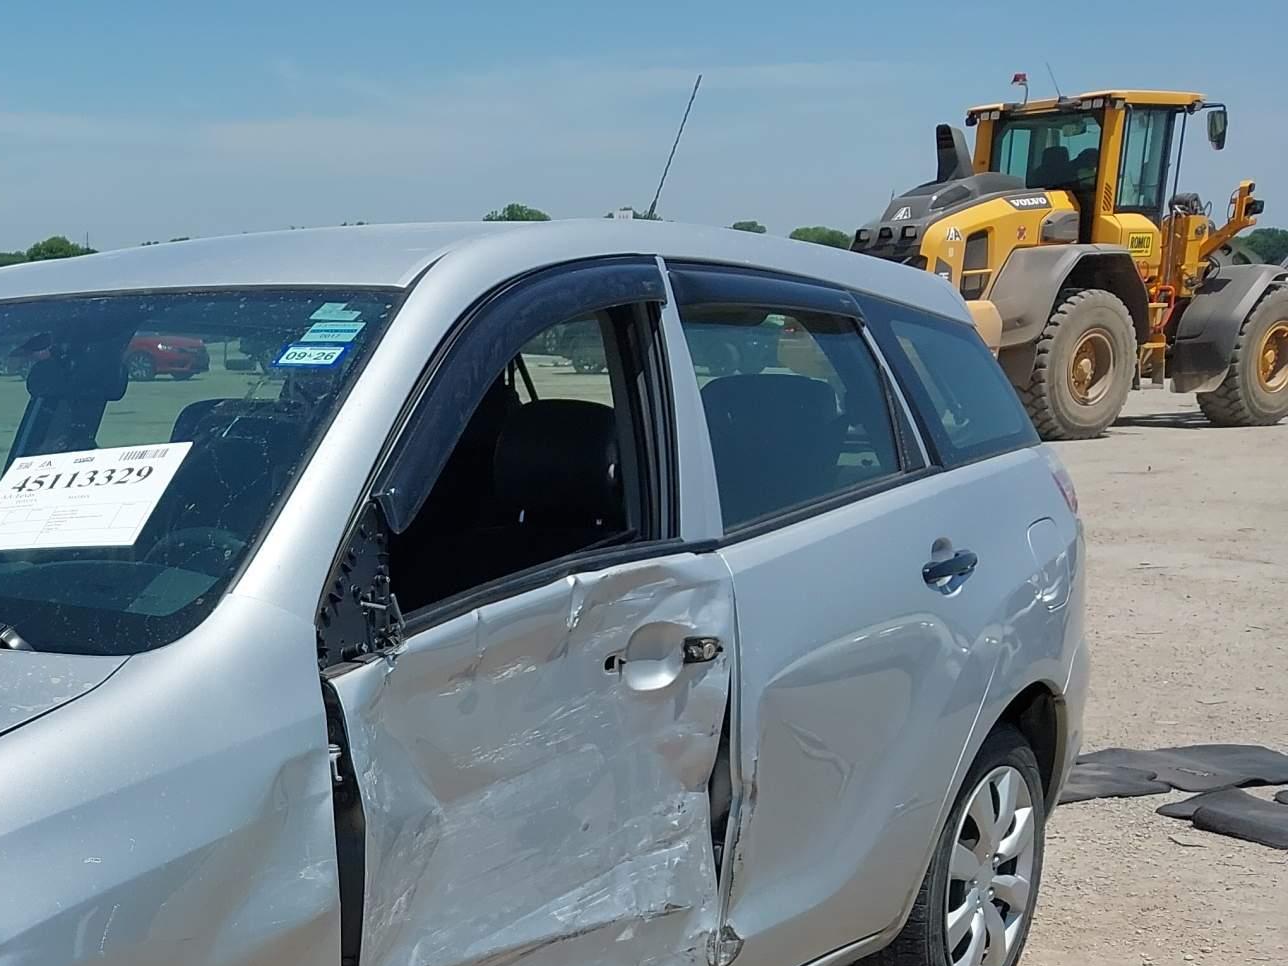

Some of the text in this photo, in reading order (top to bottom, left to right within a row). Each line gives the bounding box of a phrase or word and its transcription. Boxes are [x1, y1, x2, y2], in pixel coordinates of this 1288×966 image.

[1010, 197, 1047, 207] VOLVO
[1129, 236, 1151, 249] ROMCO
[12, 465, 154, 493] 45113329
